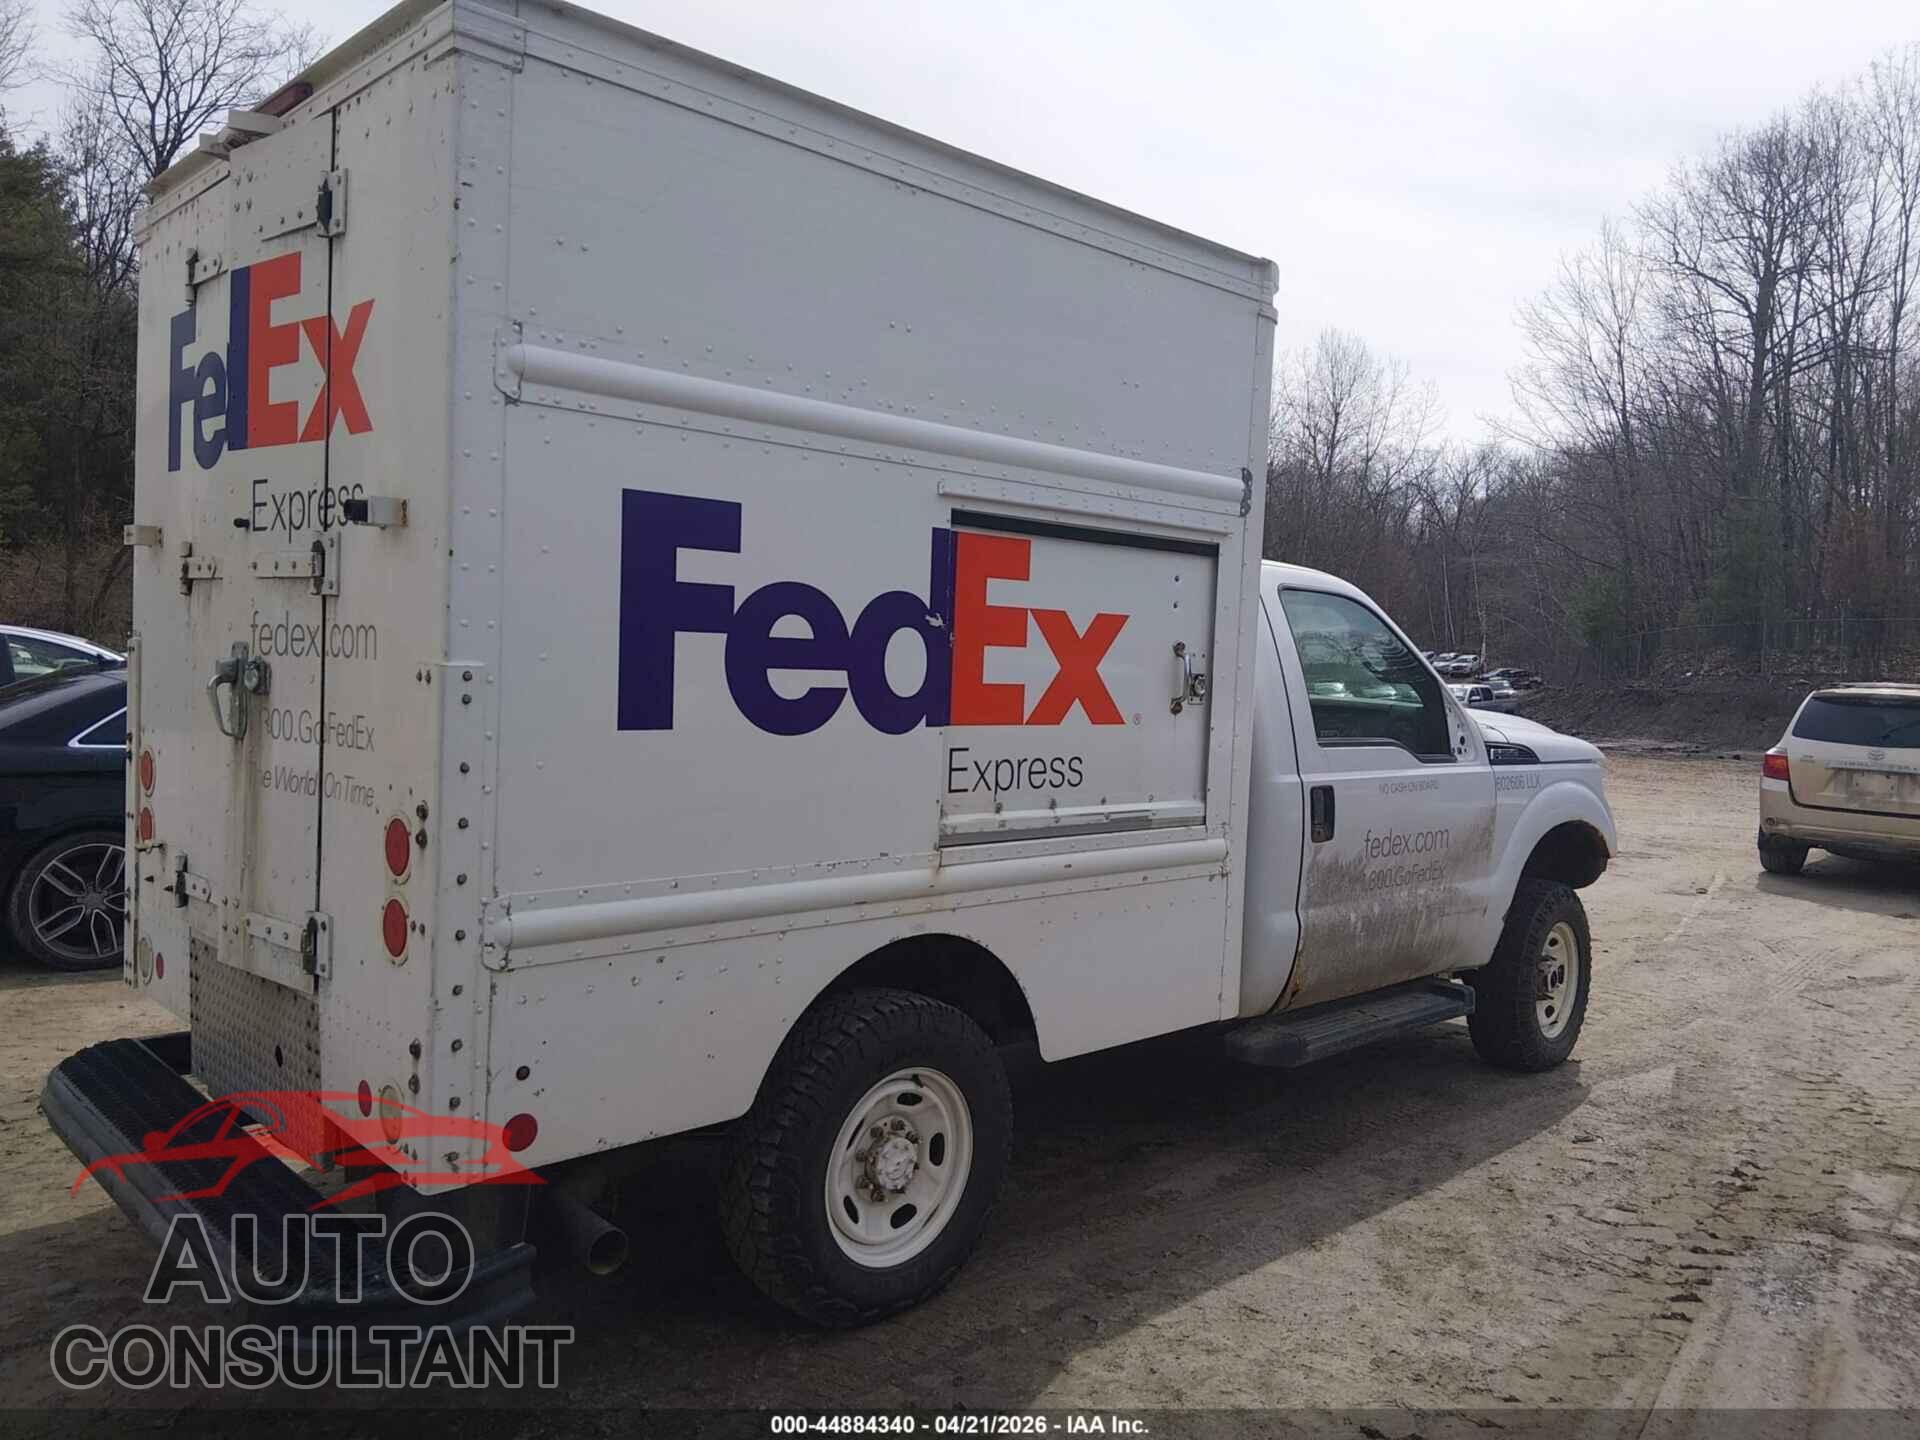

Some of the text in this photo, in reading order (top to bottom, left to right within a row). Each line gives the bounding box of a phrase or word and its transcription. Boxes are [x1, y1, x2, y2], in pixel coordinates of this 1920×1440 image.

[250, 610, 377, 661] fedex.com
[617, 488, 1131, 736] FedEx
[947, 747, 1084, 802] Express
[1363, 828, 1450, 858] fedex.com
